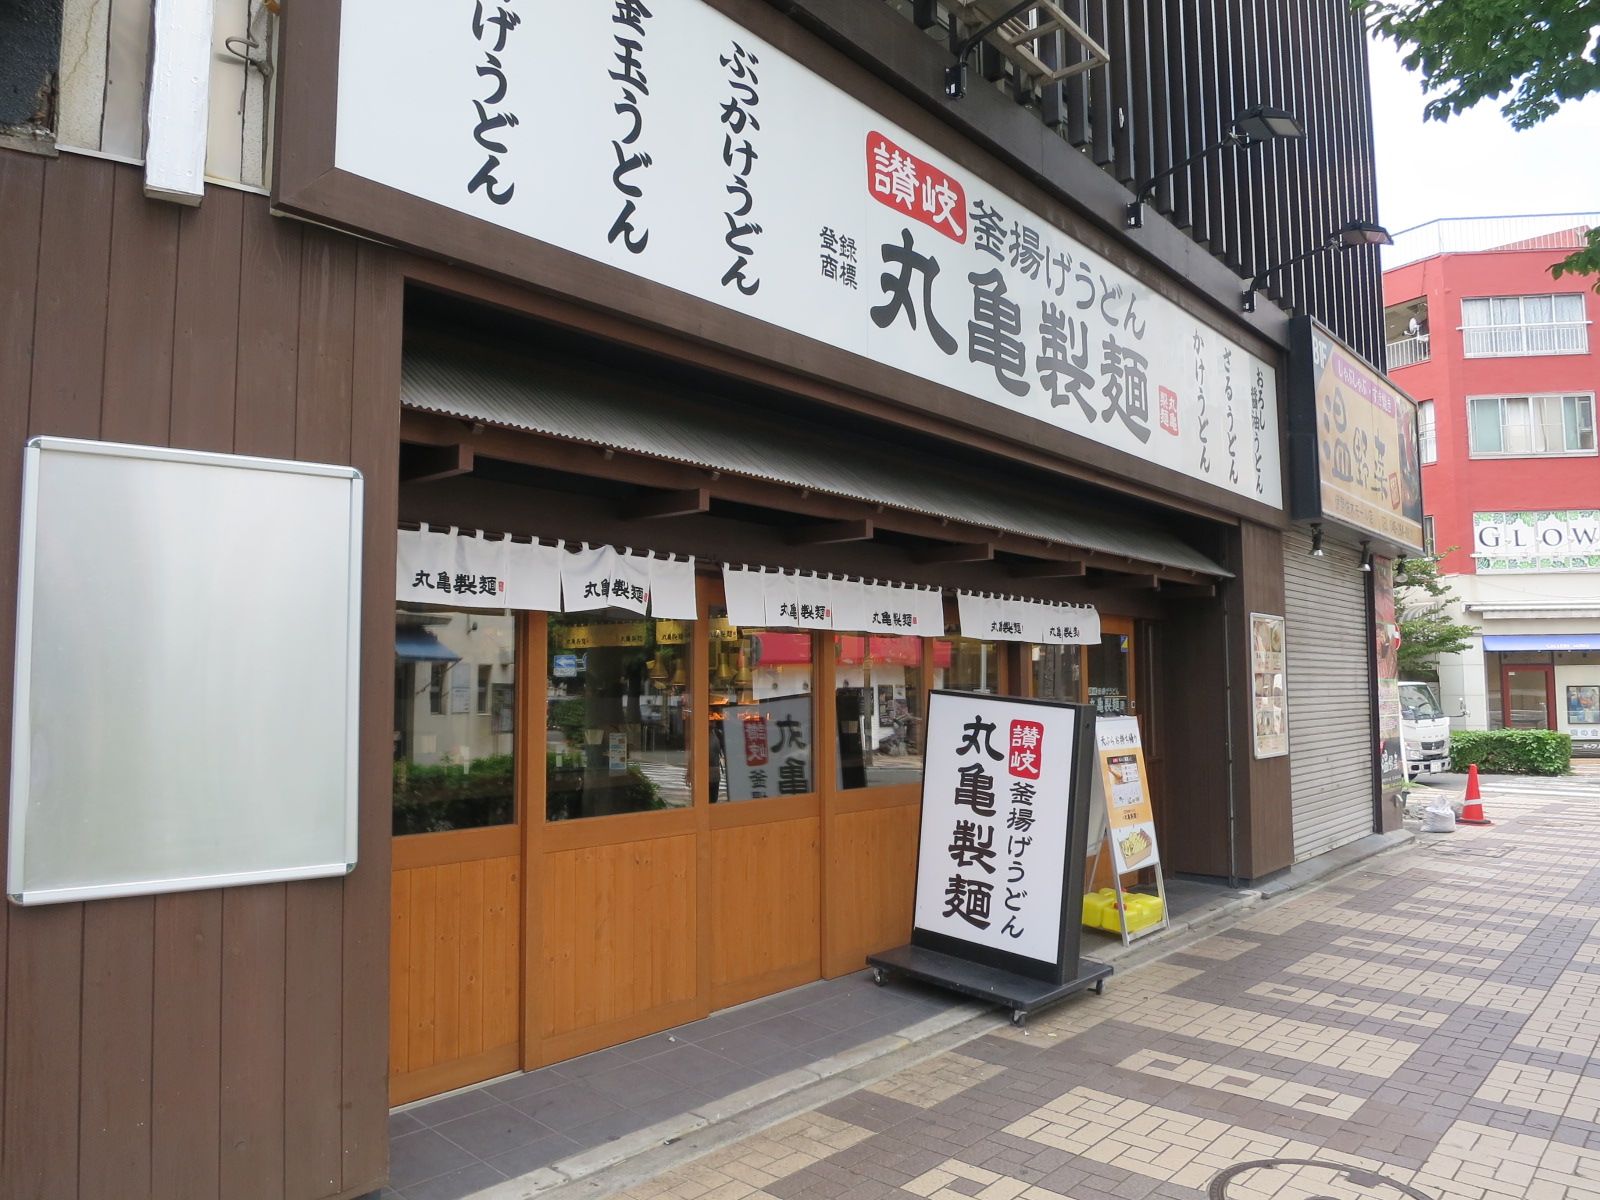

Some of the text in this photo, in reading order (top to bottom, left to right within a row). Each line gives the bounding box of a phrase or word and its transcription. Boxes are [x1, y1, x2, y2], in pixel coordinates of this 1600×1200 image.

[467, 0, 521, 205] げうどん
[718, 40, 763, 297] ぶっかけうどん
[873, 141, 964, 237] 讃岐
[968, 199, 1147, 341] 釜揚げうどん
[869, 228, 1153, 444] 丸亀製麺
[1193, 330, 1211, 473] かけうどん
[412, 570, 497, 596] 丸亀製麺
[584, 578, 644, 603] 丸亀製麺
[1478, 525, 1597, 548] GLOW
[779, 602, 826, 620] 丸亀製麺
[872, 611, 912, 627] 丸亀製麺
[1010, 725, 1040, 774] 讃岐
[942, 715, 1004, 930] 丸亀製麺
[1001, 782, 1037, 939] 釜揚げうどん
